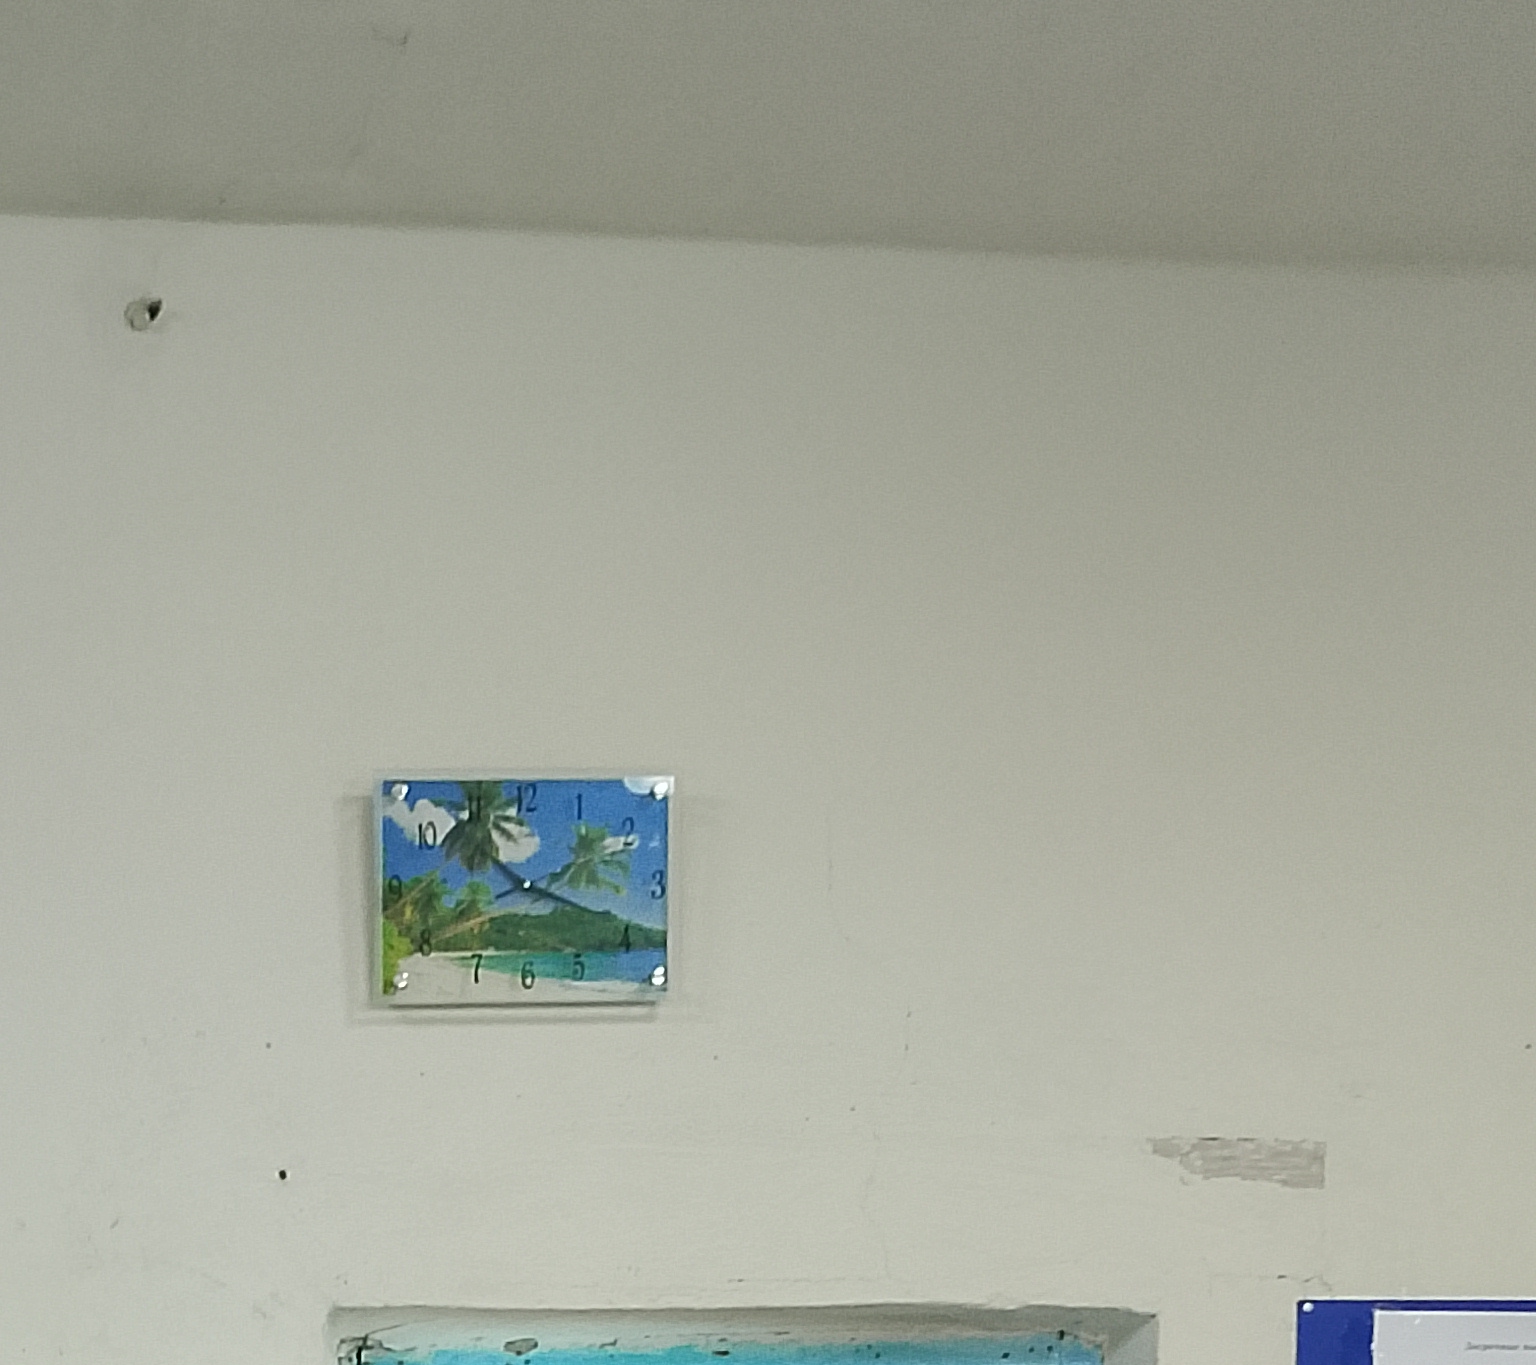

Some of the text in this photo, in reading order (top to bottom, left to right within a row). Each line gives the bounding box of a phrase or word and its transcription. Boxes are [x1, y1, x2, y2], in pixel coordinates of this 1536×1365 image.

[515, 783, 538, 814] 12
[575, 793, 583, 820] 1
[417, 820, 437, 850] 10
[621, 817, 635, 847] 2
[388, 873, 403, 903] 9
[650, 869, 666, 901] 3
[419, 929, 432, 957] 8
[470, 953, 483, 985] 7
[520, 960, 536, 989] 6
[572, 954, 586, 982] 5
